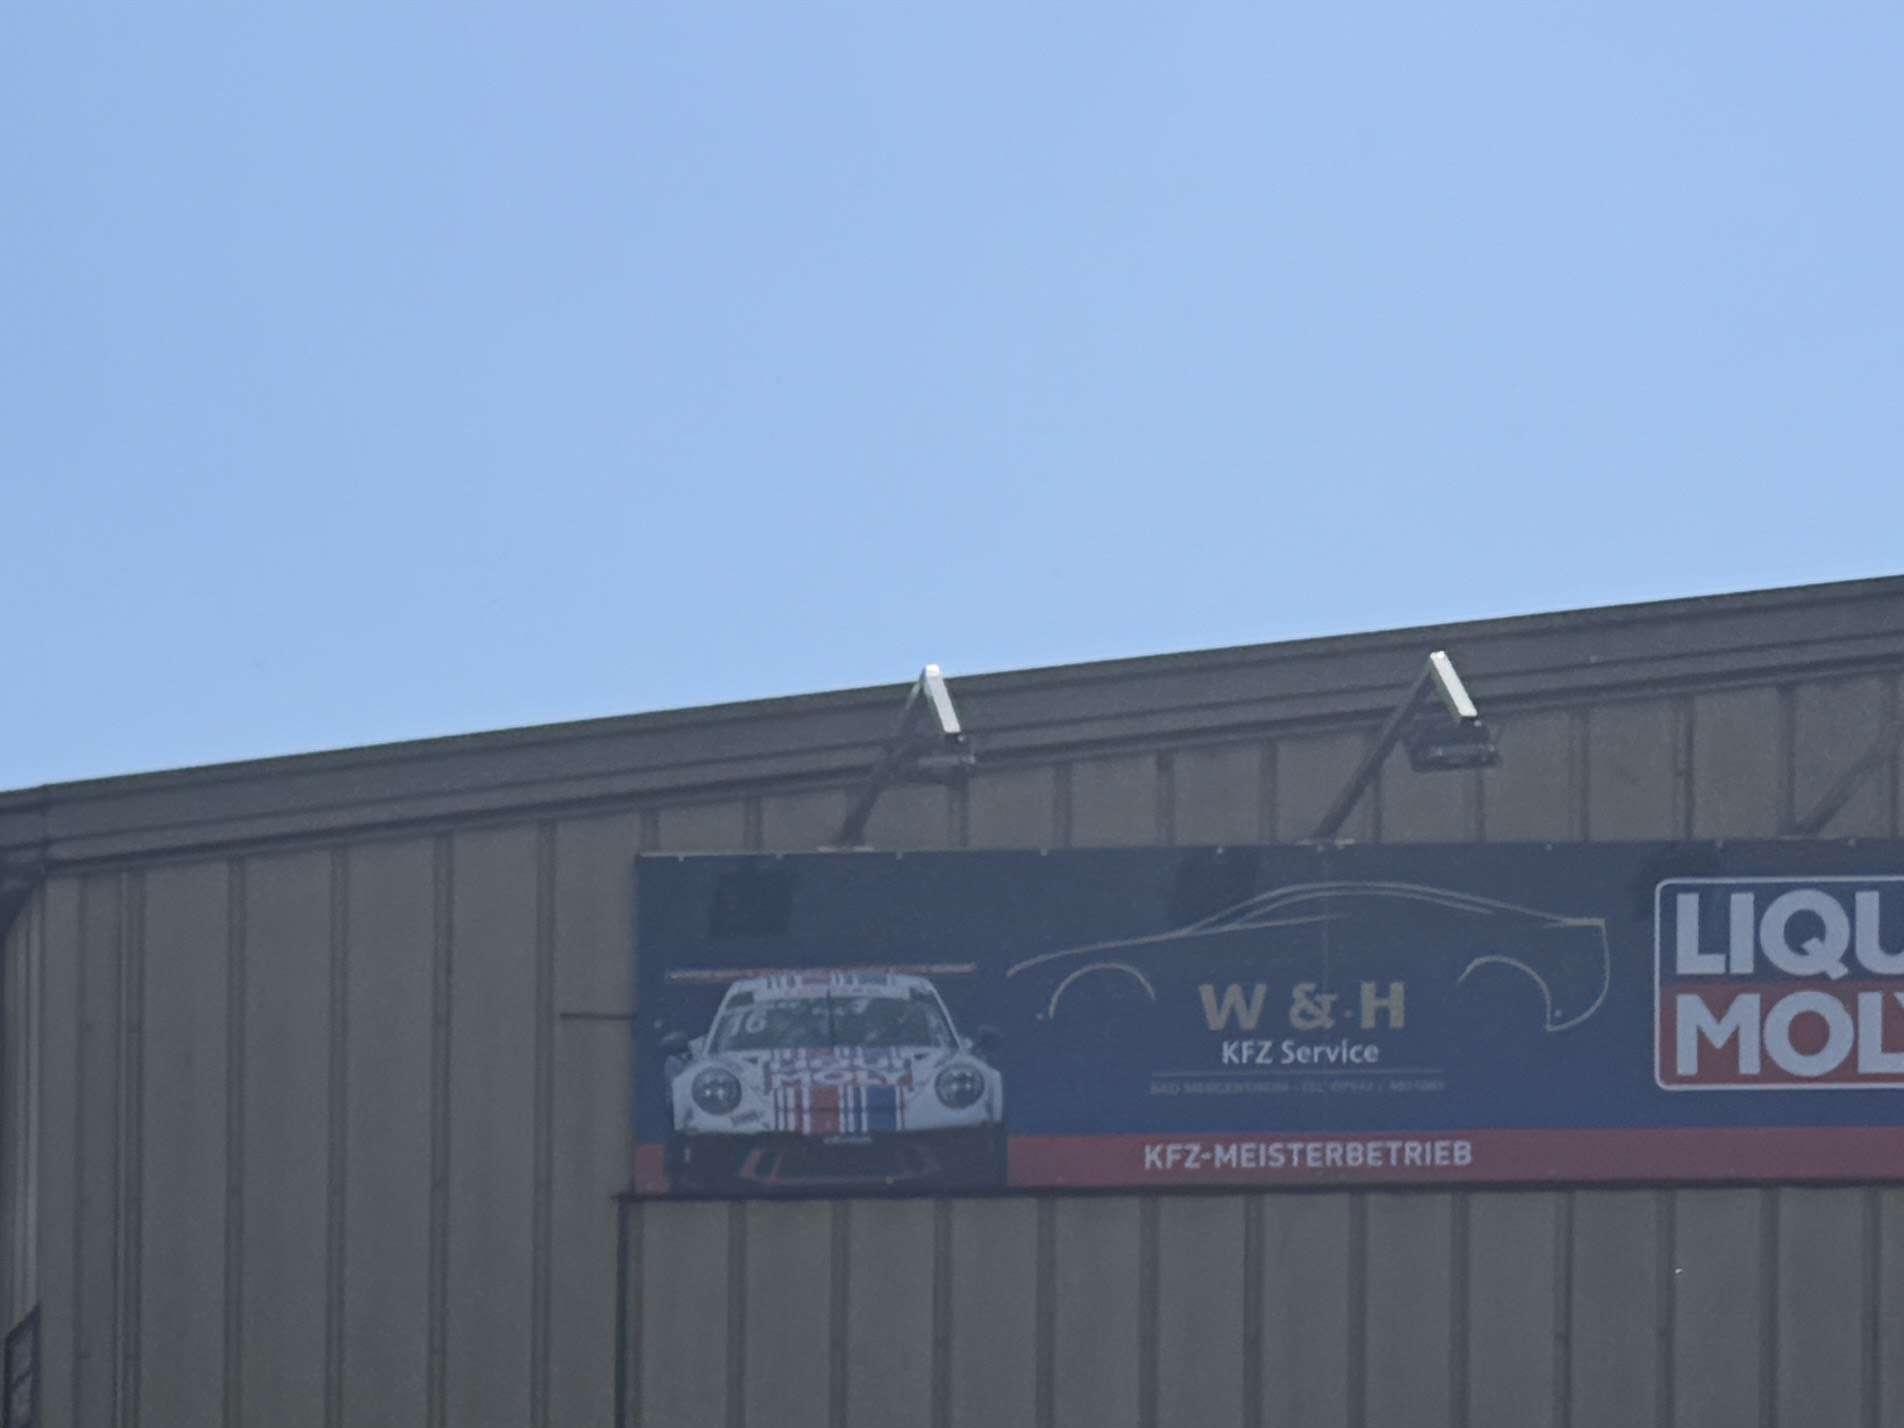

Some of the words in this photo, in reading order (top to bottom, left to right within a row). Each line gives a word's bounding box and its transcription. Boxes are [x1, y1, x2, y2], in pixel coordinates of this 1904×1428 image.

[1676, 888, 1904, 980] LIQU
[1198, 982, 1267, 1031] W
[1288, 981, 1339, 1031] &
[1360, 980, 1405, 1030] H
[1221, 1039, 1273, 1064] KFZ
[1280, 1037, 1380, 1064] Service
[1676, 990, 1904, 1077] MOL
[1143, 1139, 1473, 1170] KFZ-MEISTERBETRIEB
